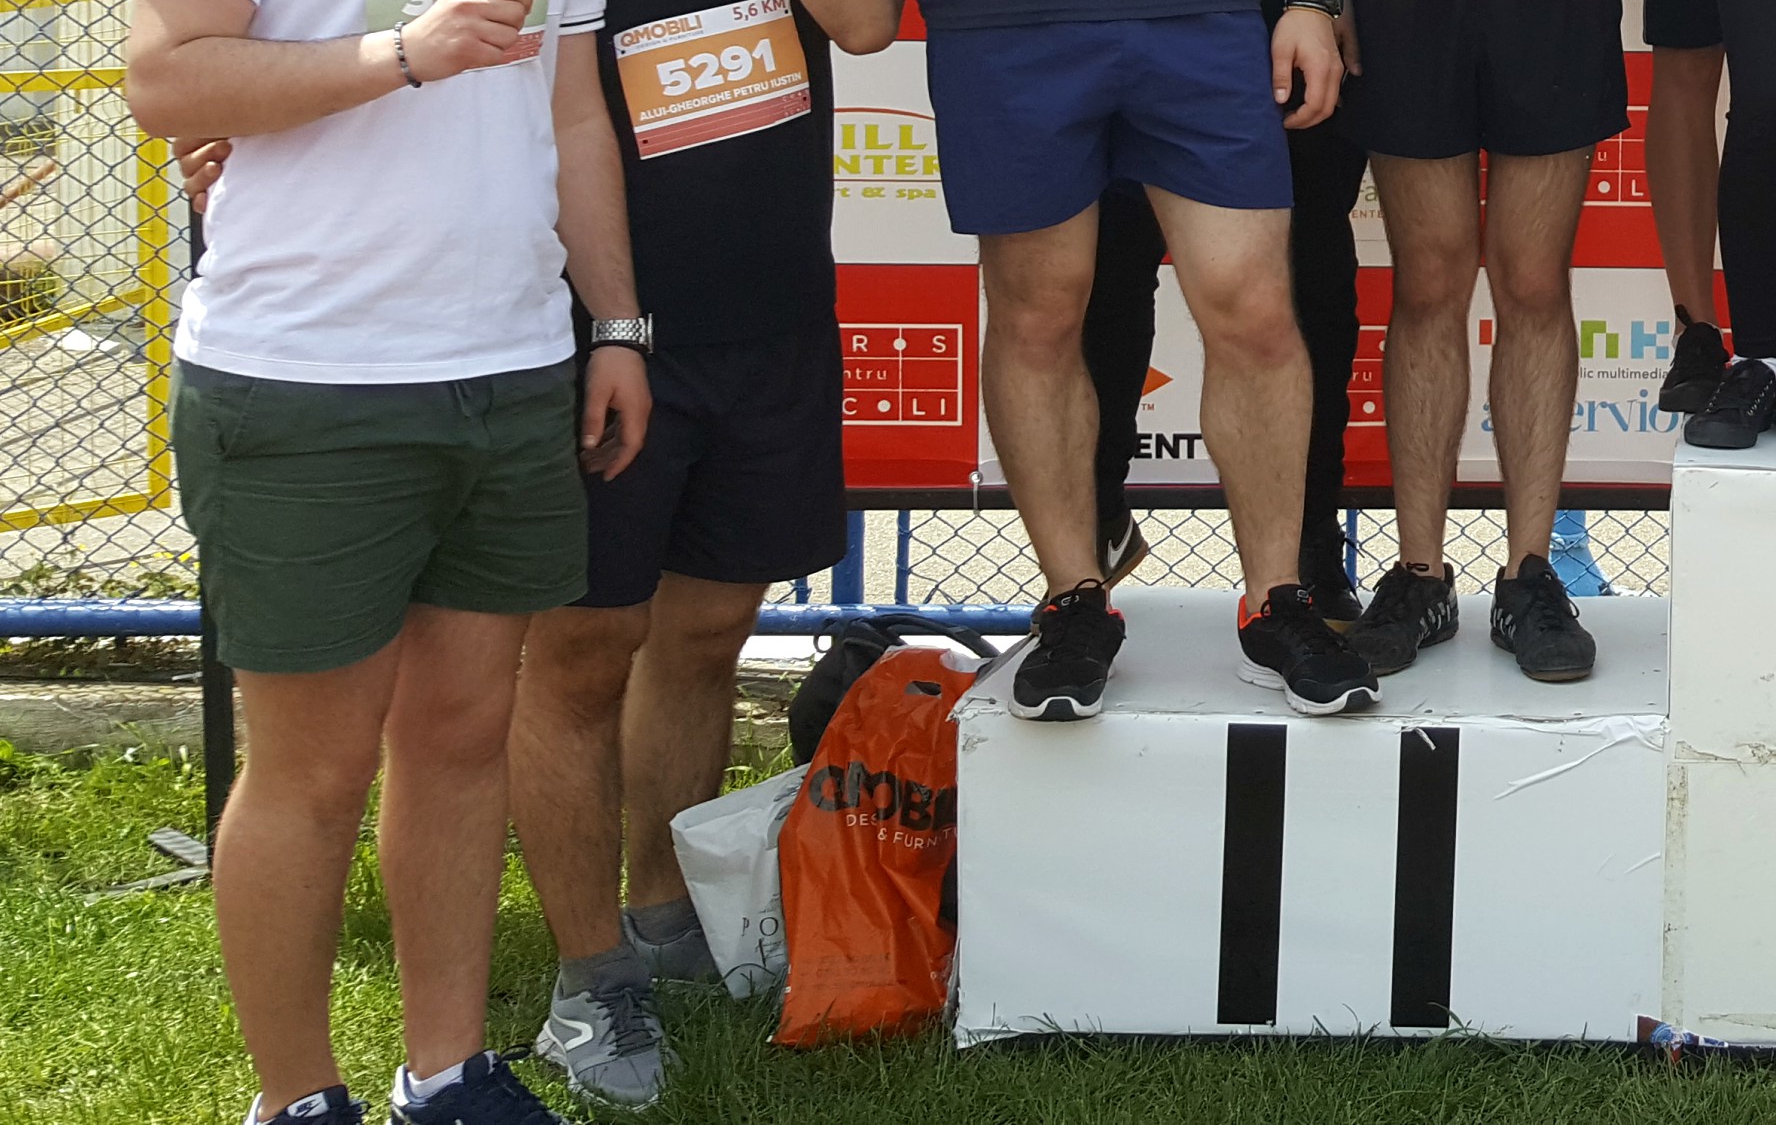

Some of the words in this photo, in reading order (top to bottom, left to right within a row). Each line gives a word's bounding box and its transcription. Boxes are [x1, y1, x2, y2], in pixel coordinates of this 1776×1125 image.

[620, 14, 703, 48] QMOBILI
[732, 2, 759, 22] 5,6
[656, 37, 777, 97] 5291
[638, 89, 732, 122] ALUI-GHEORGHE
[733, 80, 769, 98] PETRU
[770, 71, 802, 89] IUSTIN
[895, 187, 937, 201] spa
